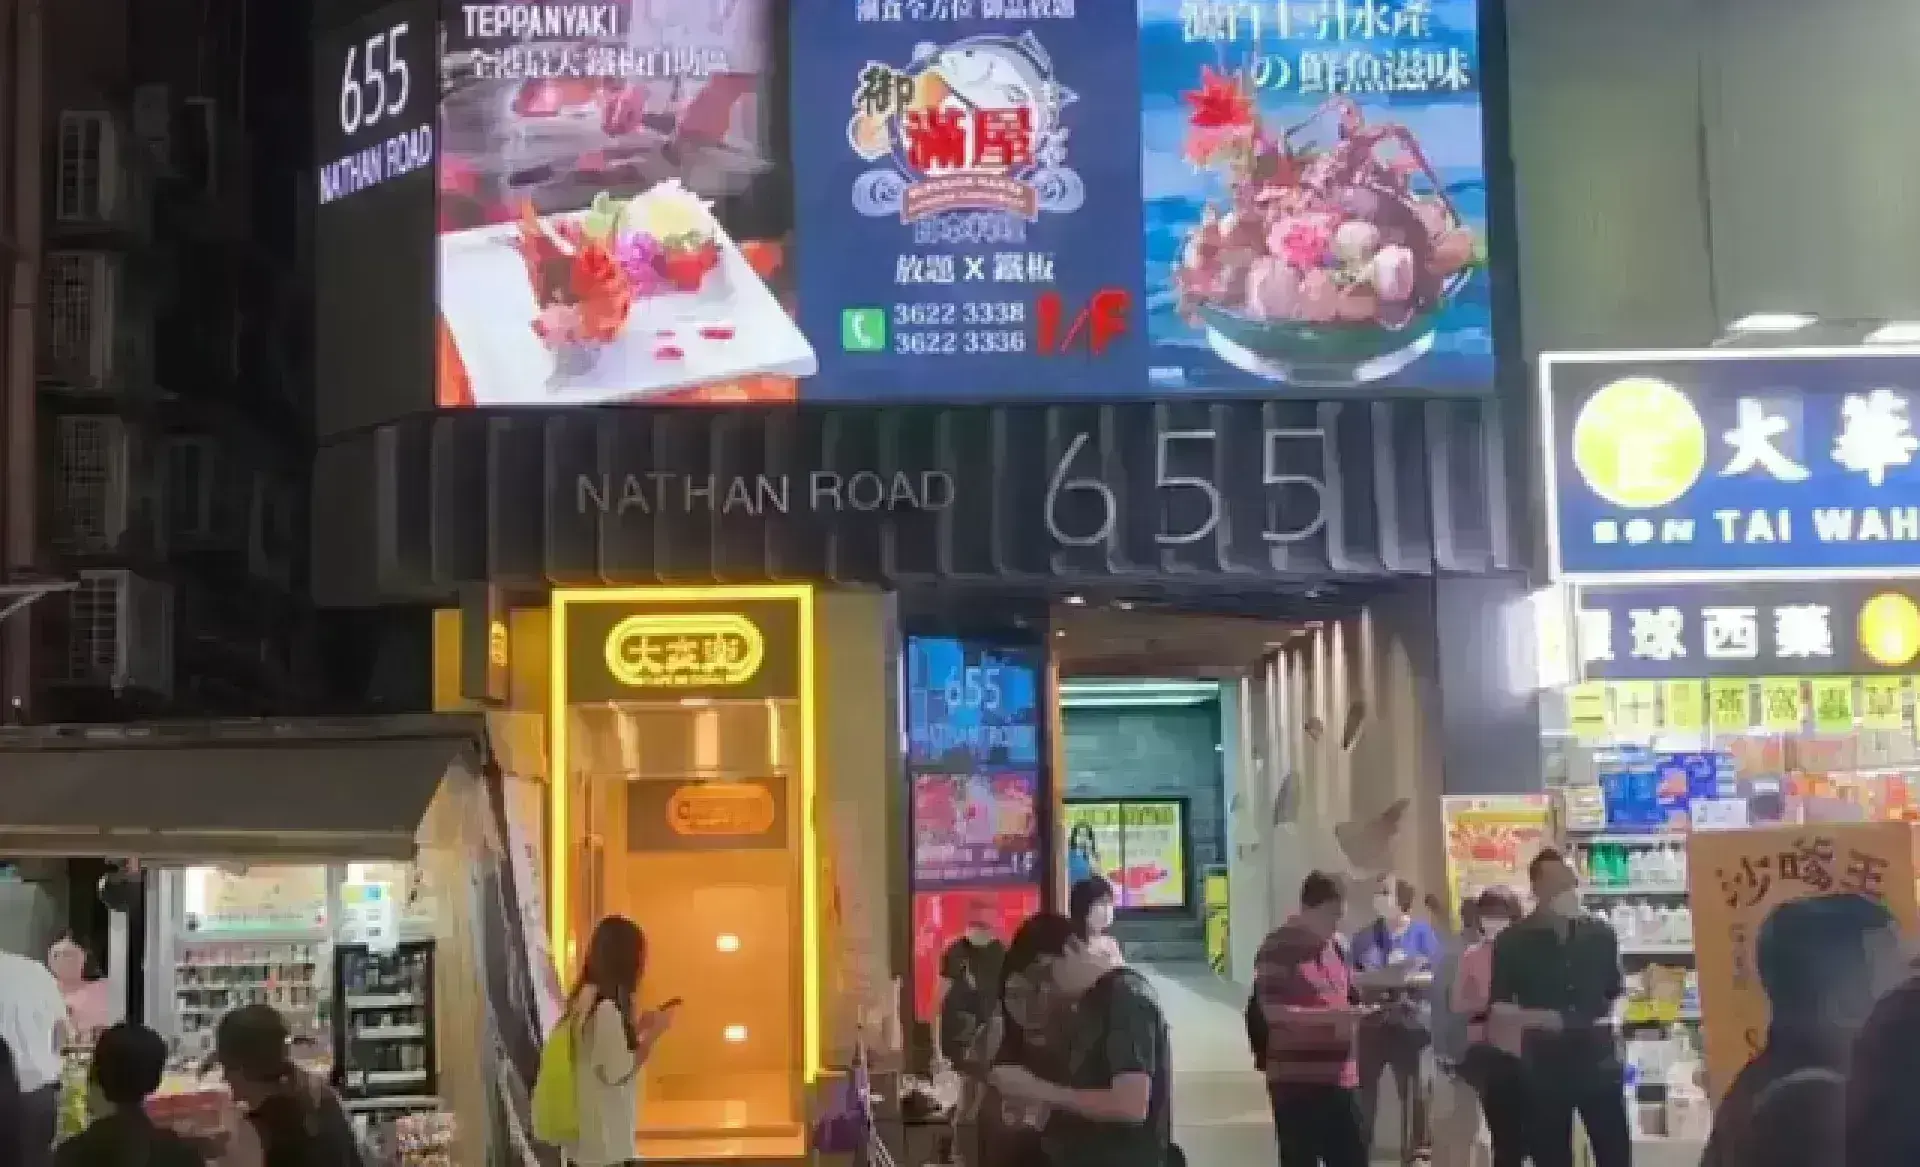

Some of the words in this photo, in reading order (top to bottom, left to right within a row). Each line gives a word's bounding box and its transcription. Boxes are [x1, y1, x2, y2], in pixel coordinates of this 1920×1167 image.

[462, 4, 617, 37] TEPPANYAKI
[339, 23, 410, 135] 655
[320, 141, 382, 204] NATHAN
[386, 124, 433, 180] ROAD
[894, 302, 955, 325] 3622
[577, 471, 790, 516] NATHAN
[809, 470, 956, 512] ROAD
[1045, 428, 1326, 546] 655
[1713, 509, 1792, 543] TAI
[1812, 507, 1920, 542] WAH
[944, 666, 1001, 710] 655
